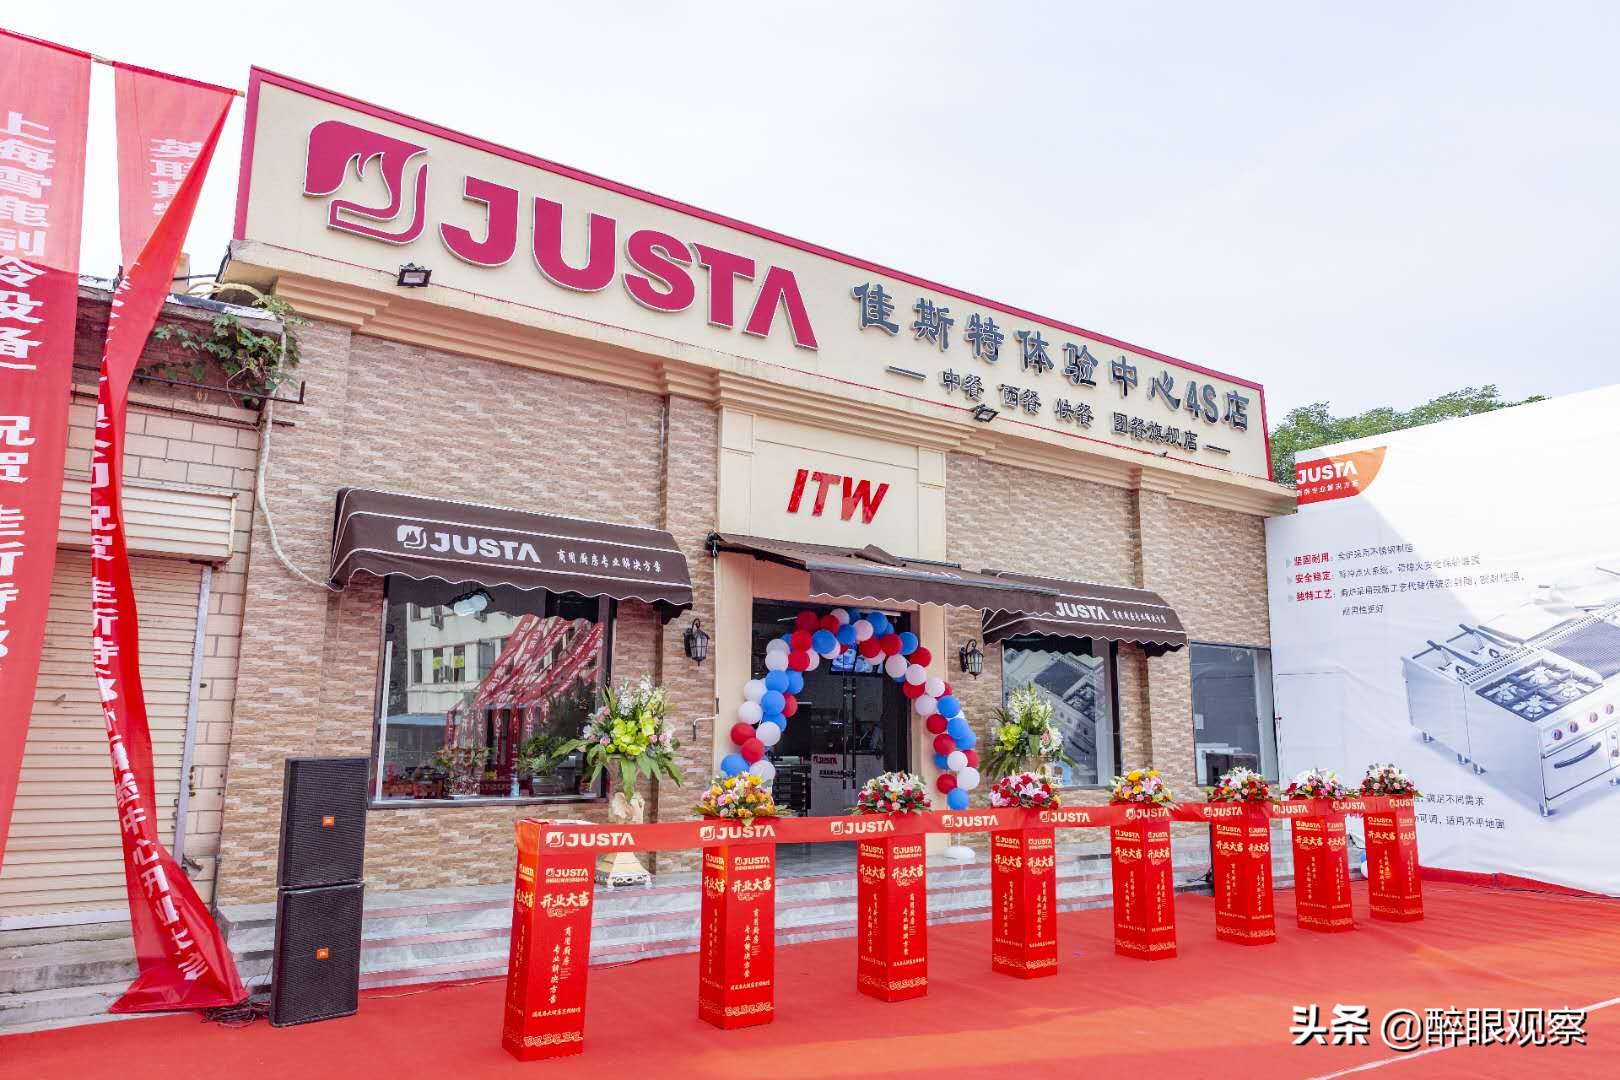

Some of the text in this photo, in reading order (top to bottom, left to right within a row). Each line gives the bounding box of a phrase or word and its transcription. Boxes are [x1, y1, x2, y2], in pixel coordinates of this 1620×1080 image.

[439, 175, 818, 351] JUSTA
[851, 281, 1251, 431] 佳斯特体验中心4S店
[1296, 460, 1359, 485] JUSTA
[786, 468, 890, 525] ITW
[429, 532, 542, 563] JUSTA
[1055, 602, 1110, 621] JUSTA
[1213, 807, 1243, 817] JUSTA
[1281, 804, 1308, 814] JUSTA
[1340, 801, 1366, 810] JUSTA
[1050, 812, 1091, 823] JUSTA
[1136, 808, 1170, 819] JUSTA
[844, 820, 895, 835] JUSTA
[955, 815, 999, 828] JUSTA
[566, 832, 635, 847] JUSTA
[717, 825, 776, 840] JUSTA
[743, 856, 770, 865] JUSTA
[555, 868, 589, 878] JUSTA
[541, 890, 590, 909] 开业大吉
